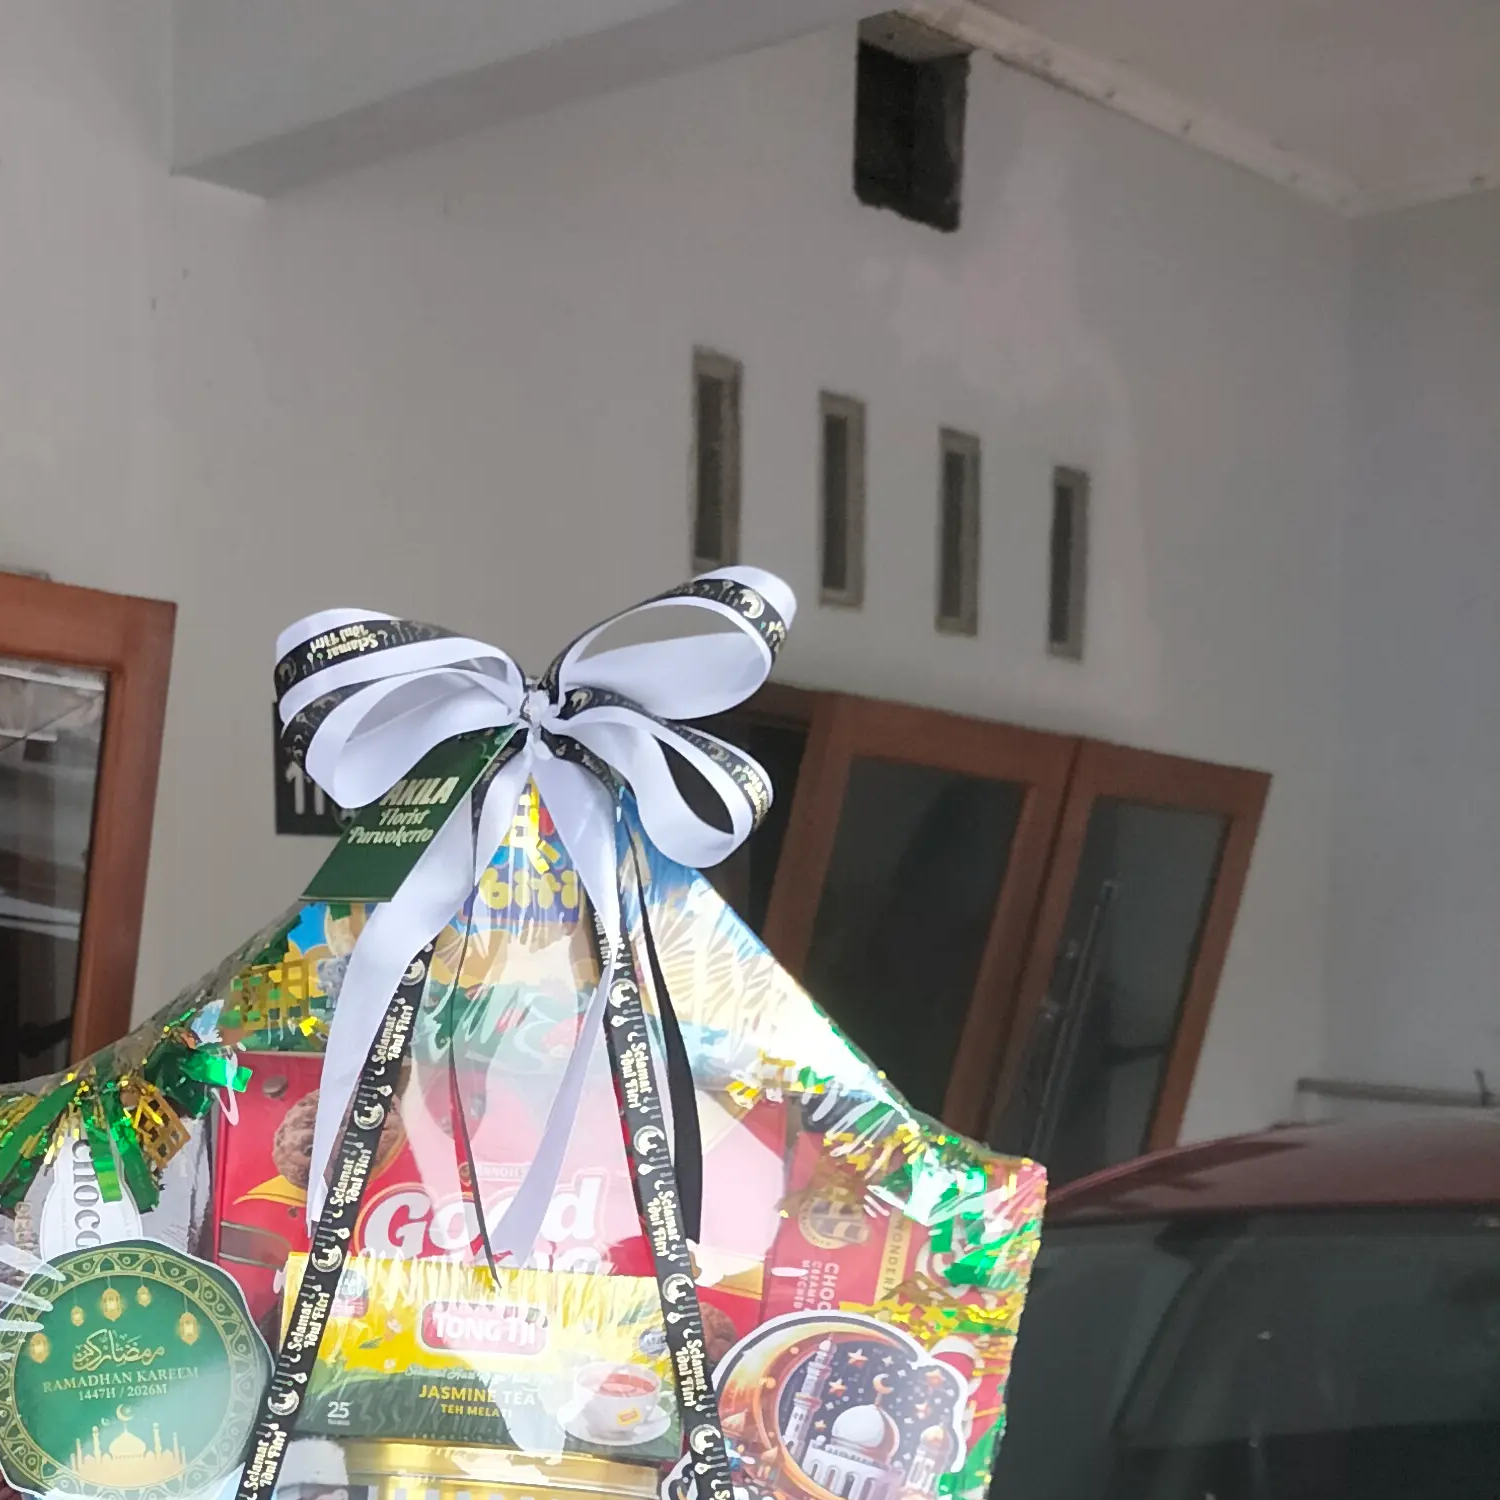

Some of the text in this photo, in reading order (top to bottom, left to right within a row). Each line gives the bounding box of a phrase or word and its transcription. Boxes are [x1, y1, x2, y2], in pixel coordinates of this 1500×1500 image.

[379, 777, 460, 805] AKILA
[379, 808, 430, 826] Florist
[348, 826, 434, 847] Purwokerto
[42, 1366, 200, 1393] RAMADHAN KAREEM
[78, 1386, 117, 1401] 1447H
[127, 1383, 168, 1397] 2026M
[418, 1383, 536, 1406] JASMINE TEA
[326, 1400, 351, 1419] 25
[440, 1403, 512, 1418] TEH MELATI
